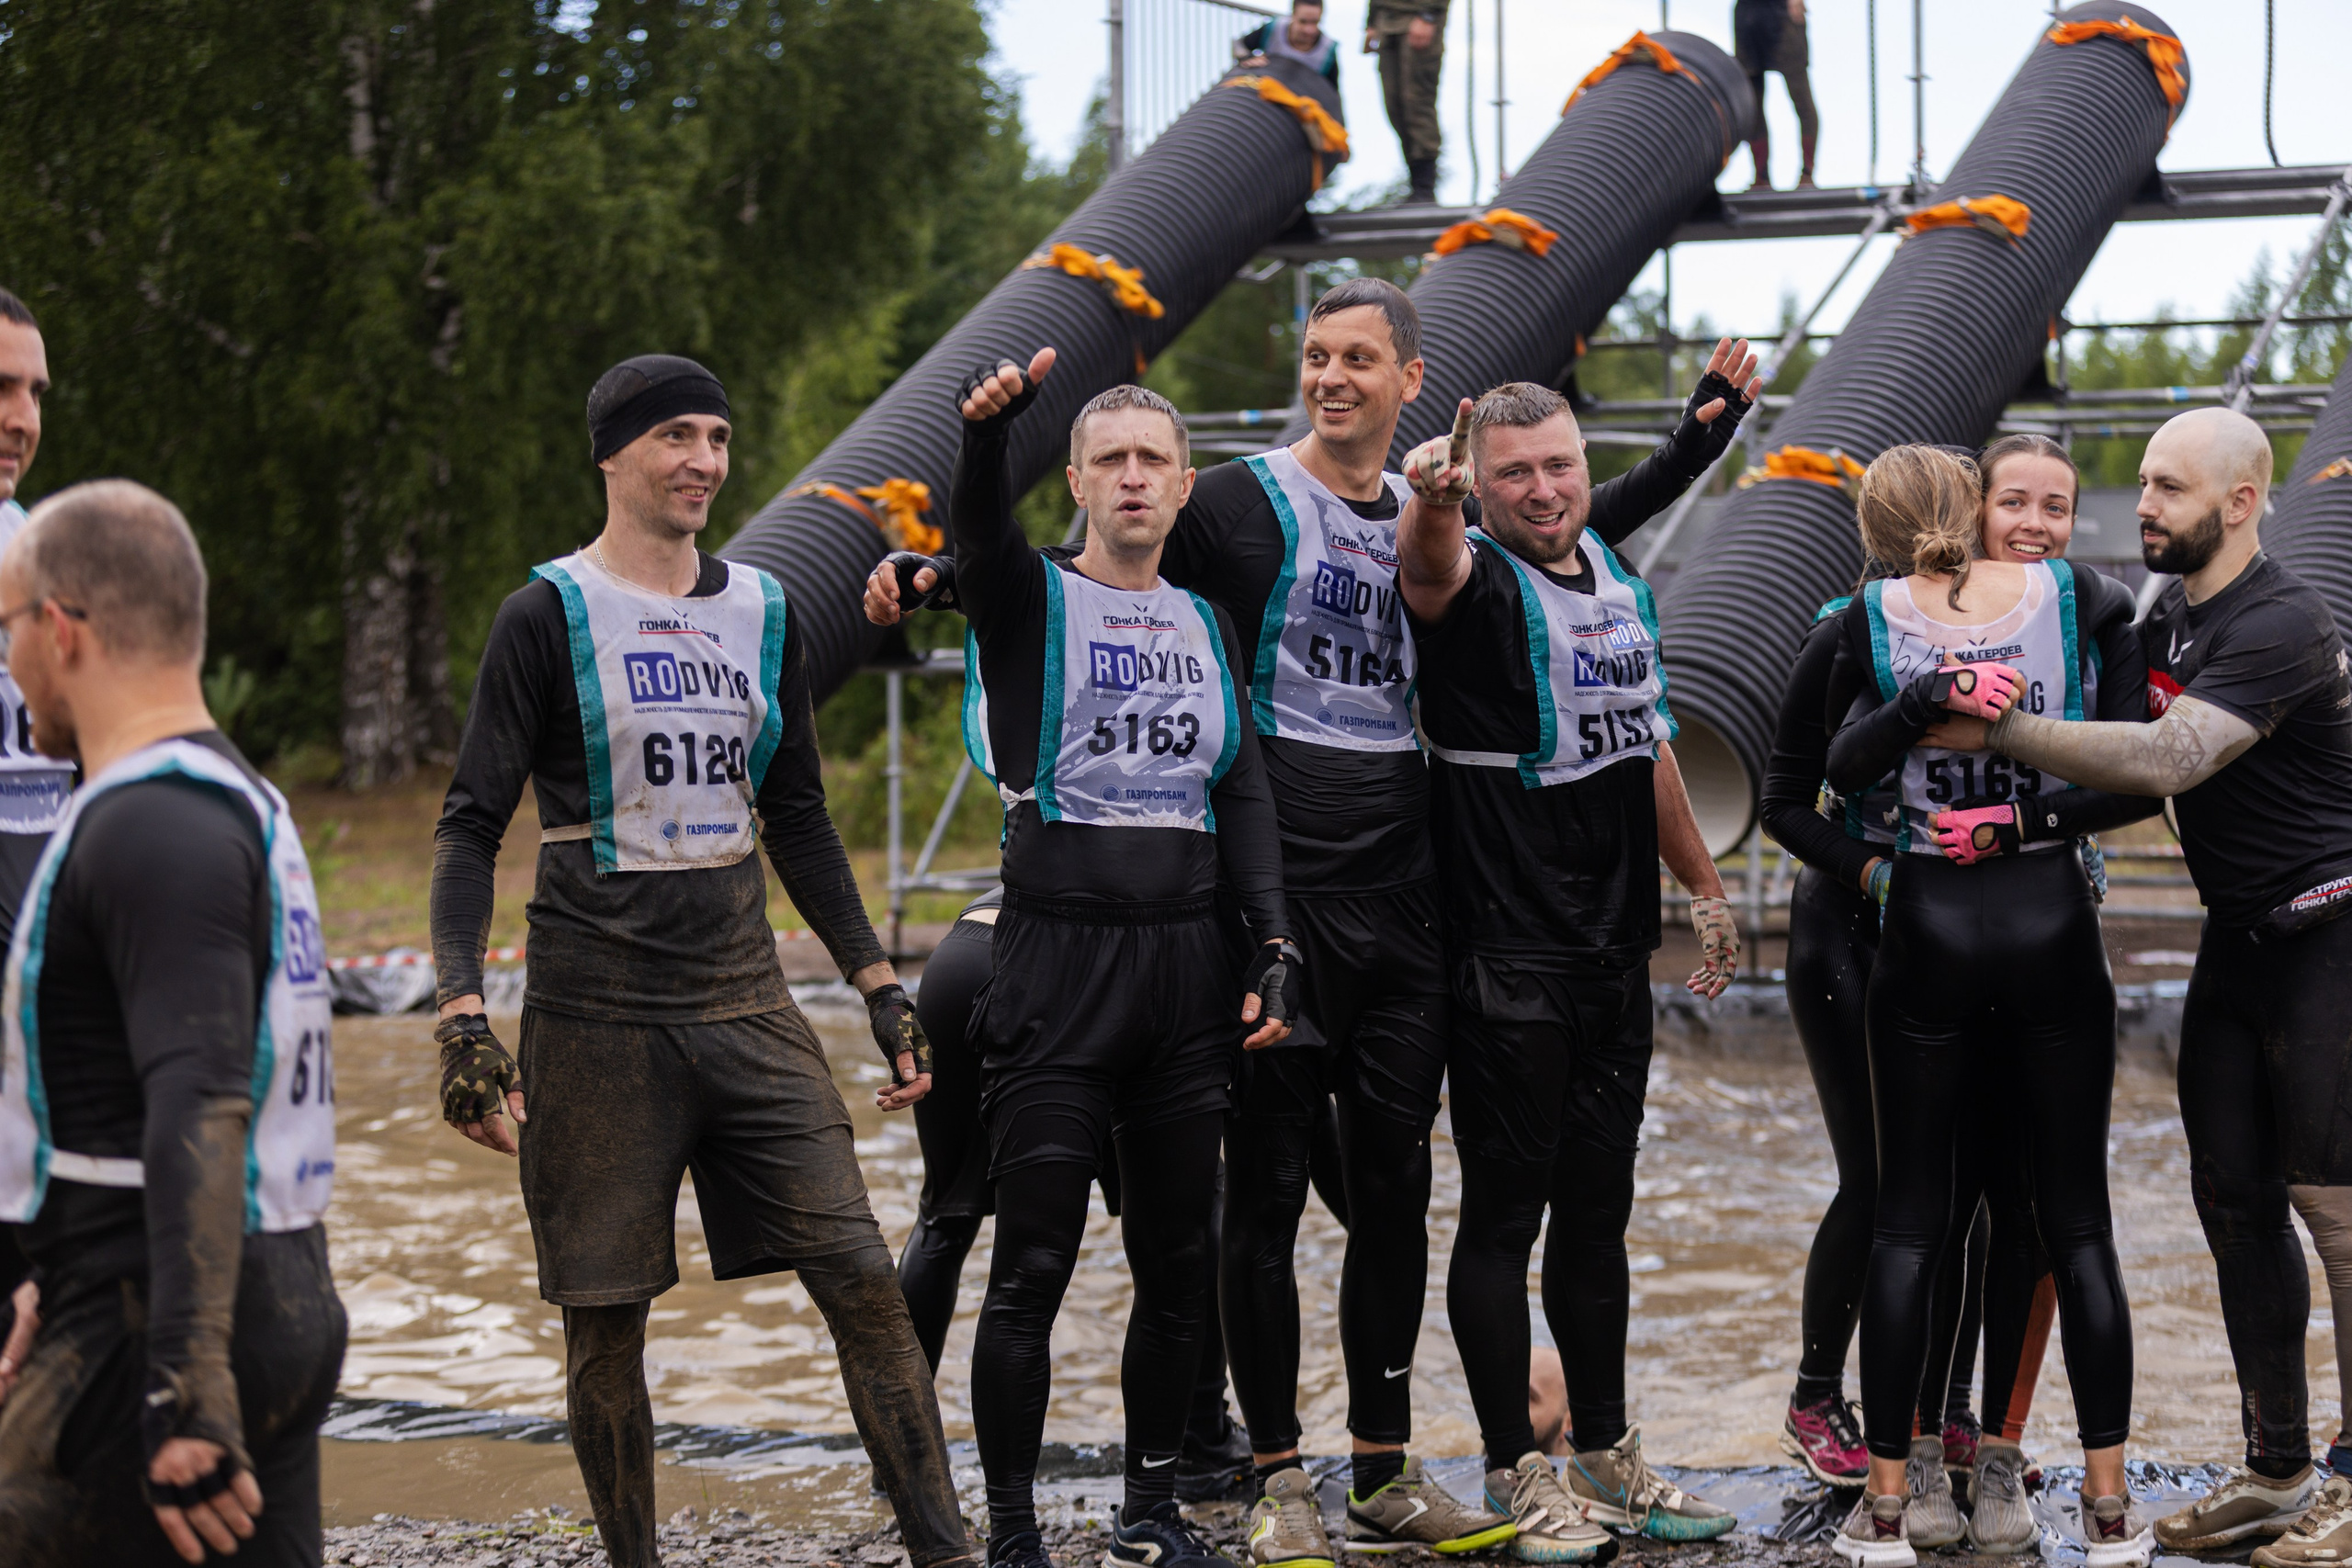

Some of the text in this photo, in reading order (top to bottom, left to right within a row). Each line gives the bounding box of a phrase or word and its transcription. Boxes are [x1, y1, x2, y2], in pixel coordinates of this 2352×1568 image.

[1317, 568, 1401, 625] RODVI
[639, 620, 681, 630] ГОНКА
[1102, 615, 1141, 626] ГОНКА
[1094, 649, 1204, 685] RODVIG
[1306, 634, 1407, 687] 5164
[1978, 645, 2022, 660] ГЕРОЕВ
[630, 660, 750, 701] RODVIG
[1088, 712, 1200, 758] 5163
[1340, 716, 1396, 730] ГАЗПРОМБАНК
[643, 732, 746, 786] 6120
[1125, 788, 1187, 801] ГАЗПРОМБАНК
[1927, 755, 2041, 804] 5165
[686, 823, 739, 835] ГАЗПРОМБАНК
[2291, 897, 2328, 911] ГОНКА
[290, 1031, 334, 1106] 61
